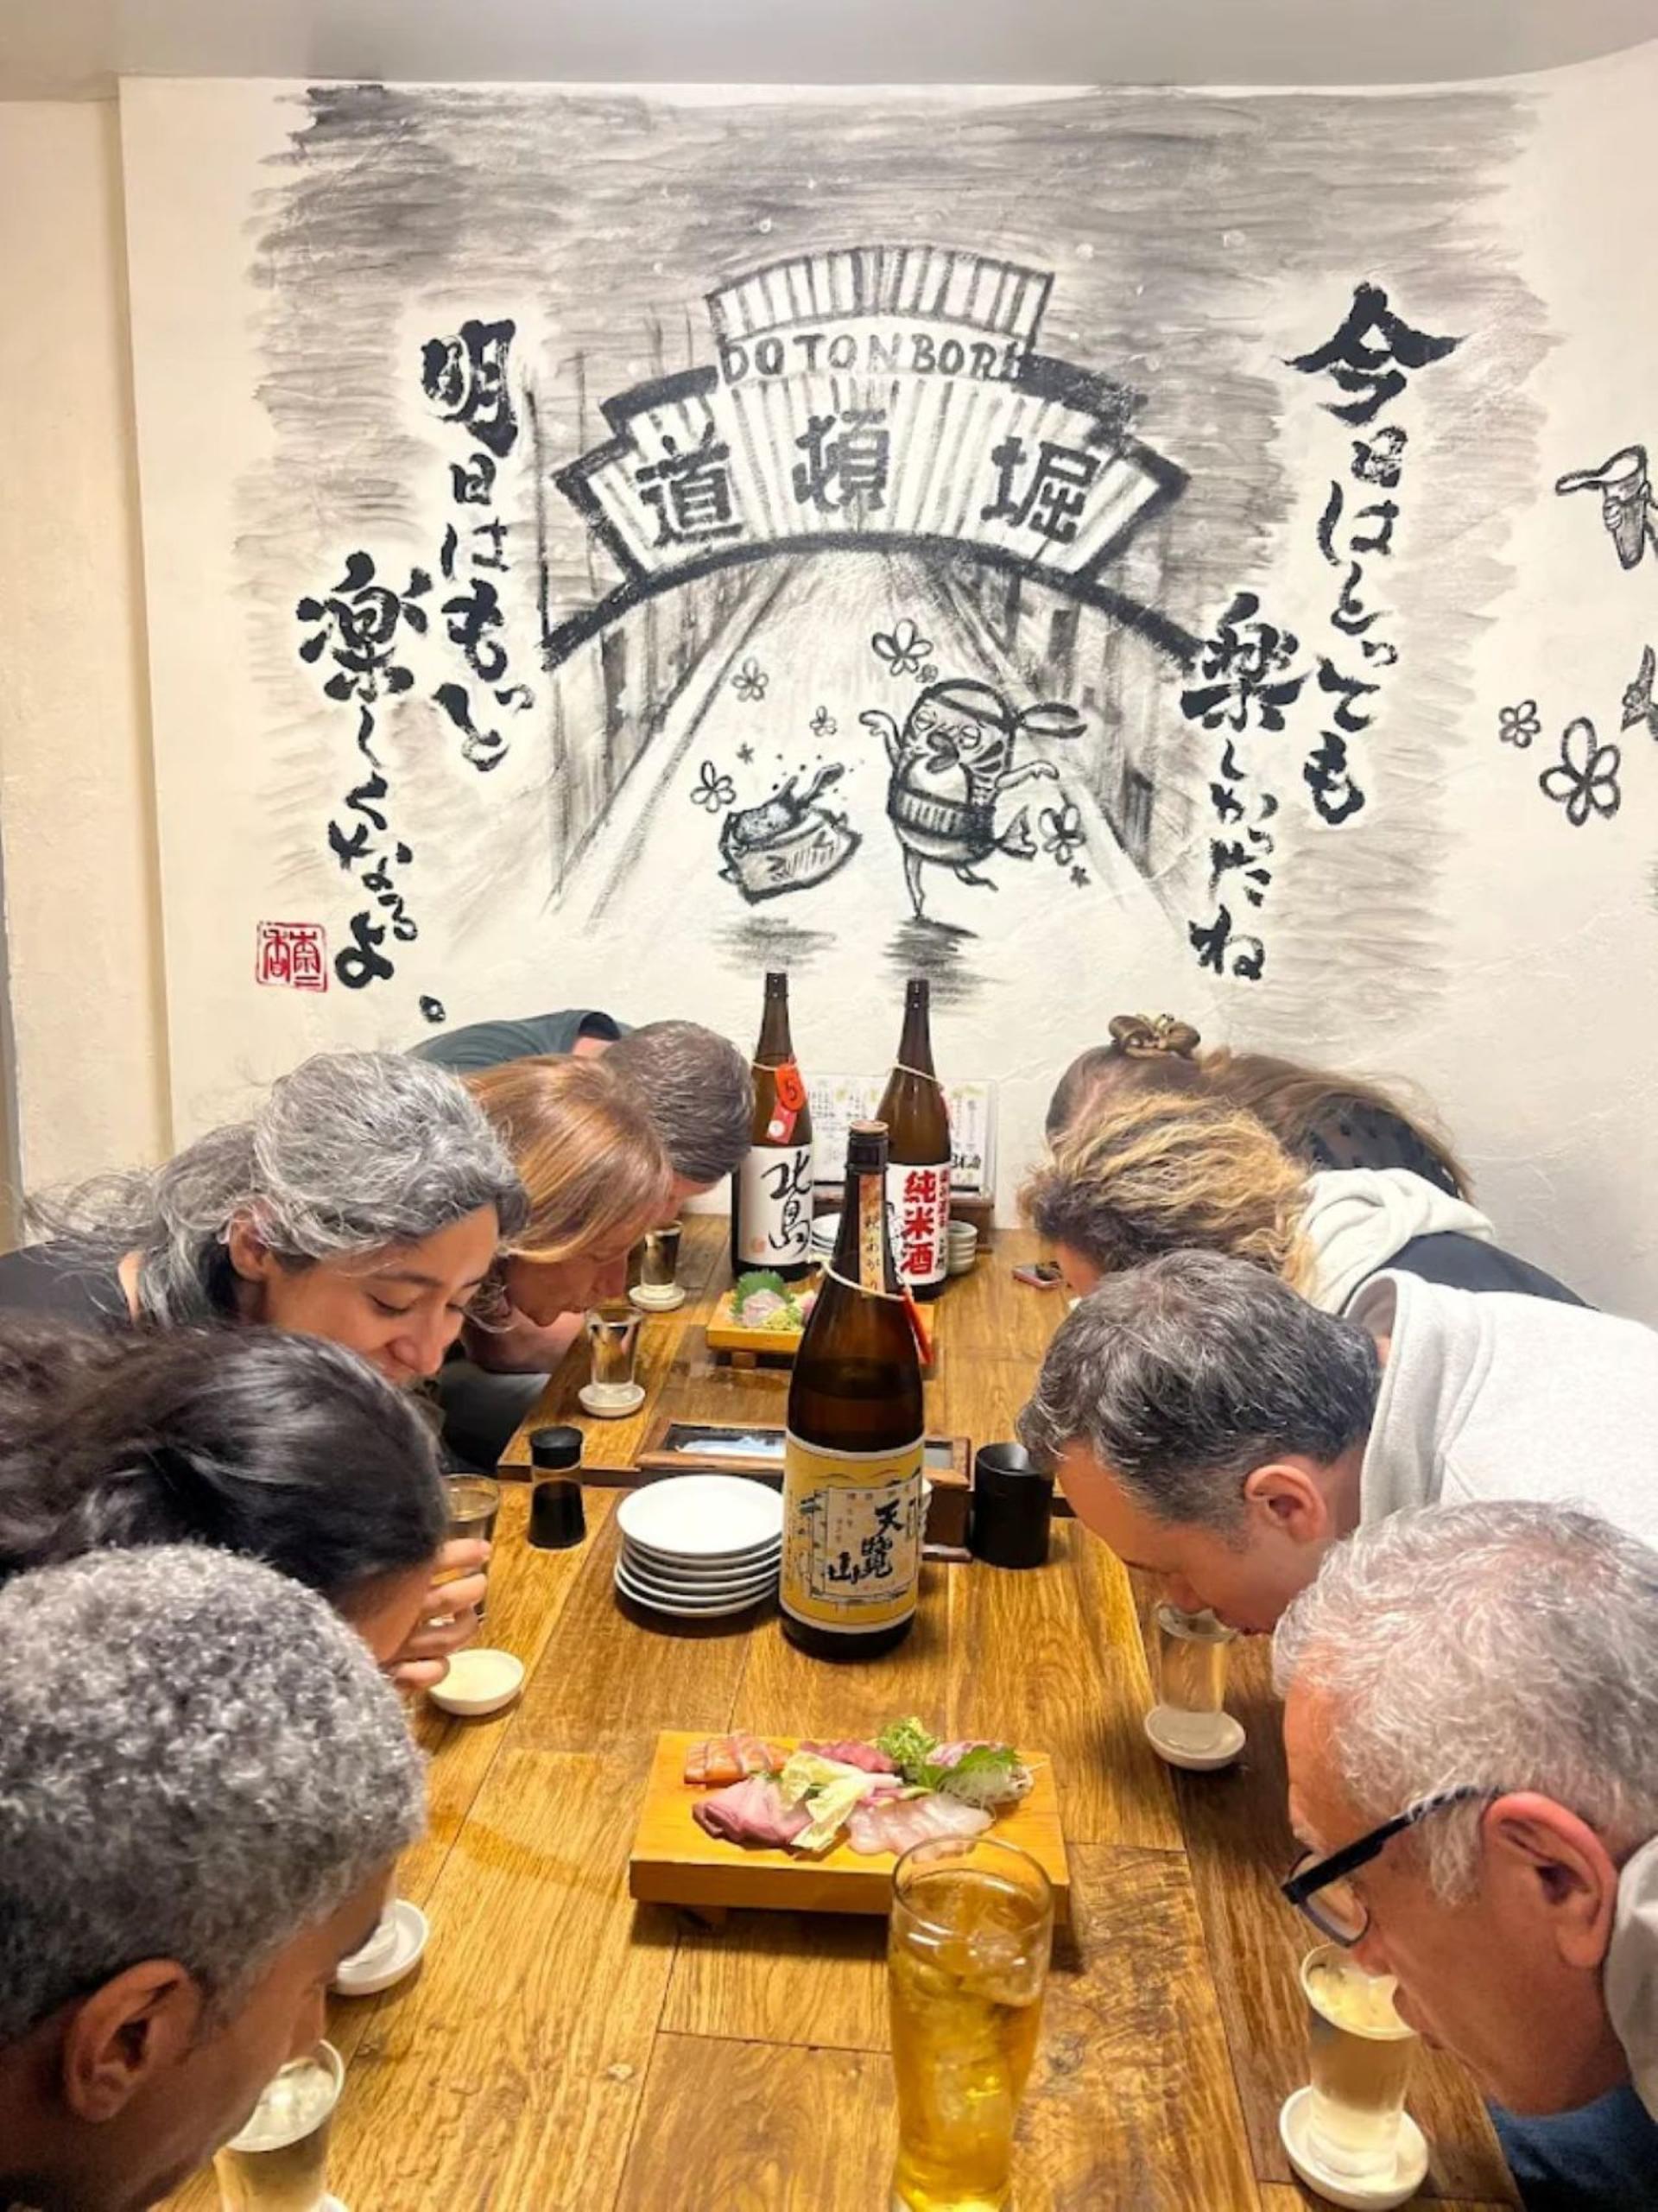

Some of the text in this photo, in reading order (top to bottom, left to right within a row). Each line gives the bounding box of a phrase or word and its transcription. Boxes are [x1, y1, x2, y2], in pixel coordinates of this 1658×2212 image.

[421, 319, 535, 771] 明日はもっと
[635, 408, 1102, 551] 道頓堀
[1281, 282, 1467, 825] 今日はとっても
[900, 1169, 936, 1275] 純米酒
